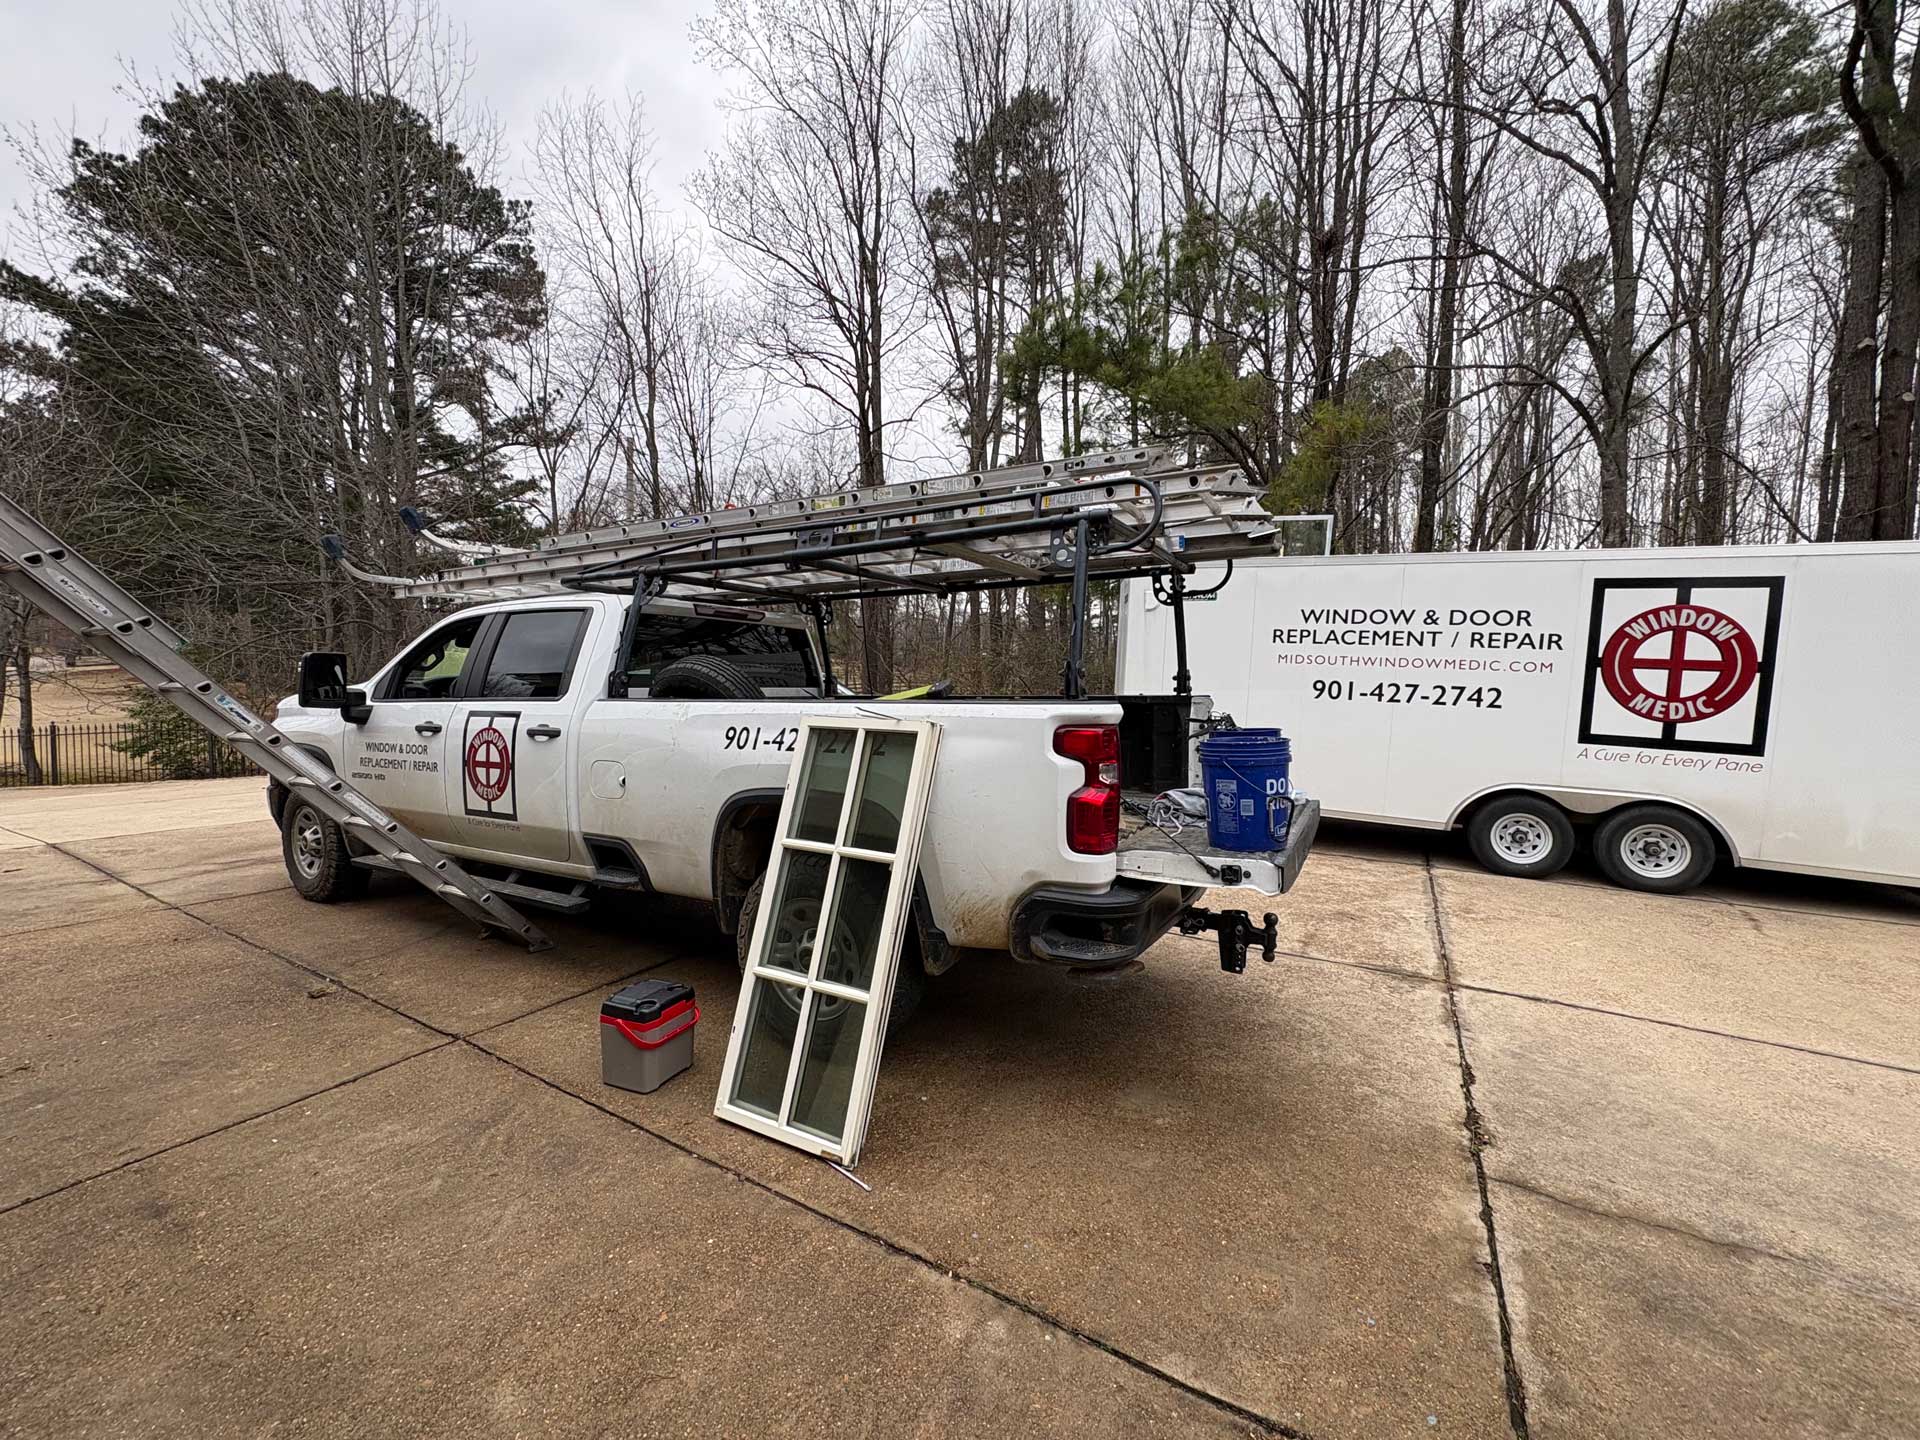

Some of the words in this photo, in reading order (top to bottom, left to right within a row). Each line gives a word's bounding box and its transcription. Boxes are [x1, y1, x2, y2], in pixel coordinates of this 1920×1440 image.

[1301, 608, 1416, 625] WINDOW
[1422, 609, 1440, 626] &
[1448, 609, 1533, 627] DOOR
[1624, 609, 1740, 642] WINDOW
[1272, 628, 1443, 648] REPLACEMENT
[1450, 631, 1460, 648] /
[1469, 631, 1564, 651] REPAIR
[1277, 653, 1554, 674] MIDSOUTHWINDOWMEDIC.COM
[1312, 679, 1502, 709] 901-427-2742
[1628, 693, 1715, 720] MEDIC
[365, 742, 398, 754] WINDOW
[398, 744, 405, 754] &
[405, 744, 428, 756] DOOR
[472, 729, 505, 751] WINDOW
[359, 757, 408, 771] REPLACEMENT
[413, 760, 439, 773] REPAIR
[1577, 748, 1590, 760] A
[1594, 748, 1631, 763] Cure
[1635, 750, 1660, 765] for
[1662, 753, 1711, 770] Every
[1715, 758, 1764, 773] Pane
[476, 782, 501, 800] MEDIC
